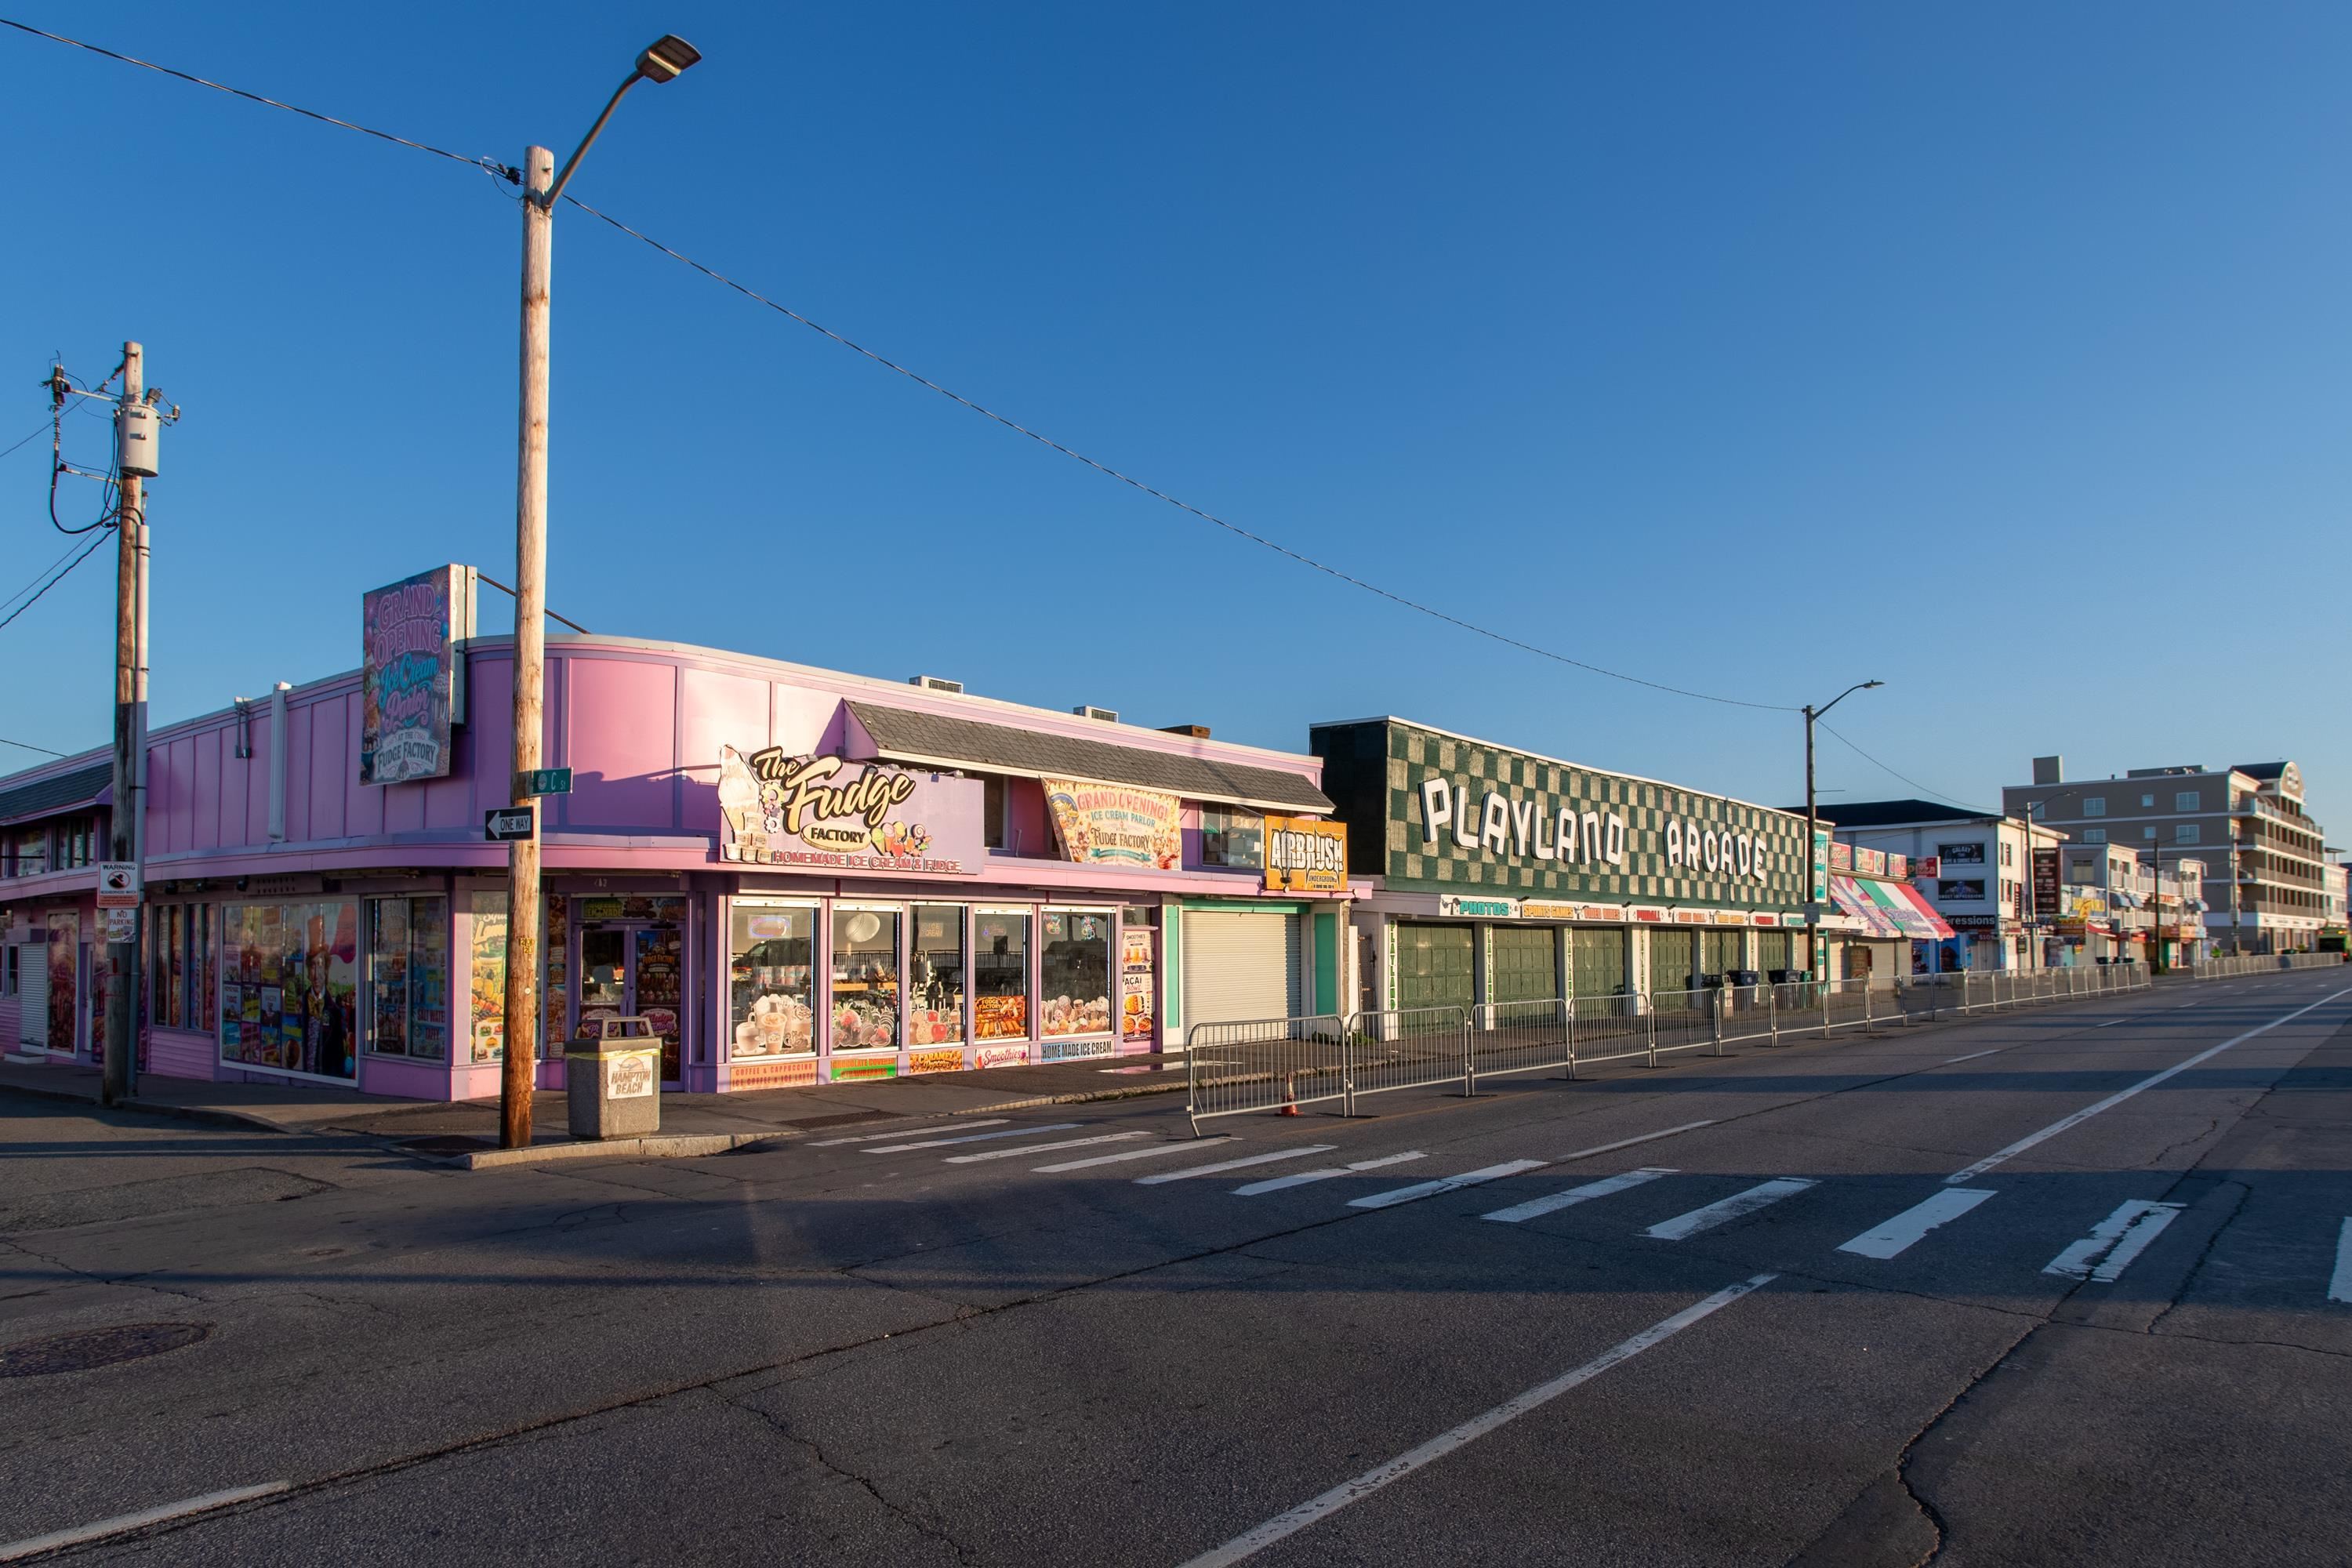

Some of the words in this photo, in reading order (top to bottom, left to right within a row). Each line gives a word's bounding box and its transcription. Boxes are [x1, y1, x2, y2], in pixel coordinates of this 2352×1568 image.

[379, 584, 436, 633] GRAND
[374, 619, 441, 670] OPENING
[379, 664, 400, 709] Ice
[400, 653, 439, 688] Cream
[383, 684, 428, 732] Parlor
[405, 731, 414, 739] THE
[378, 745, 401, 772] FUDGE
[404, 742, 436, 764] FACTORY
[751, 746, 801, 780] The
[551, 771, 557, 790] C
[561, 780, 566, 789] St
[784, 754, 915, 834] Fudge
[1077, 789, 1116, 811] GRAND
[1119, 792, 1169, 822] OPENING!
[501, 818, 514, 831] ONE
[516, 817, 529, 830] WAY
[1091, 811, 1104, 822] ICE
[1105, 810, 1129, 822] CREAM
[1131, 812, 1156, 829] PARLOR
[811, 827, 866, 844] FACTORY
[1419, 777, 1624, 866] PLAYLAND
[1664, 819, 1767, 881] ARCADE
[1091, 827, 1117, 847] FUDGE
[1119, 832, 1150, 852] FACTORY
[1270, 829, 1344, 873] AIRBRUSH
[773, 851, 845, 867] HOMEMADE
[847, 854, 866, 868] ICE
[870, 855, 911, 869] CREAM
[913, 858, 922, 869] &
[924, 858, 961, 873] FUDGE
[1907, 865, 1936, 876] Pizza
[1308, 874, 1338, 883] UNDERGROUND
[1460, 901, 1508, 916] PHOTOS
[1523, 905, 1550, 917] SPORTS
[1551, 906, 1573, 918] GAMES
[918, 1052, 953, 1064] CARAMEL
[984, 1048, 1022, 1065] Smoothies
[1043, 1045, 1061, 1059] HOME
[1062, 1044, 1079, 1058] MADE
[1080, 1043, 1090, 1056] ICE
[1091, 1040, 1112, 1055] CREAM
[735, 1068, 759, 1076] COFFEE
[771, 1063, 812, 1073] CAPPUCCINO
[868, 1058, 895, 1066] COVERED
[924, 1060, 950, 1071] Popcorn
[612, 1070, 651, 1084] HAMPTON
[747, 1076, 771, 1085] COFFEE
[794, 1073, 814, 1081] LATTE
[615, 1082, 643, 1094] BEACH
